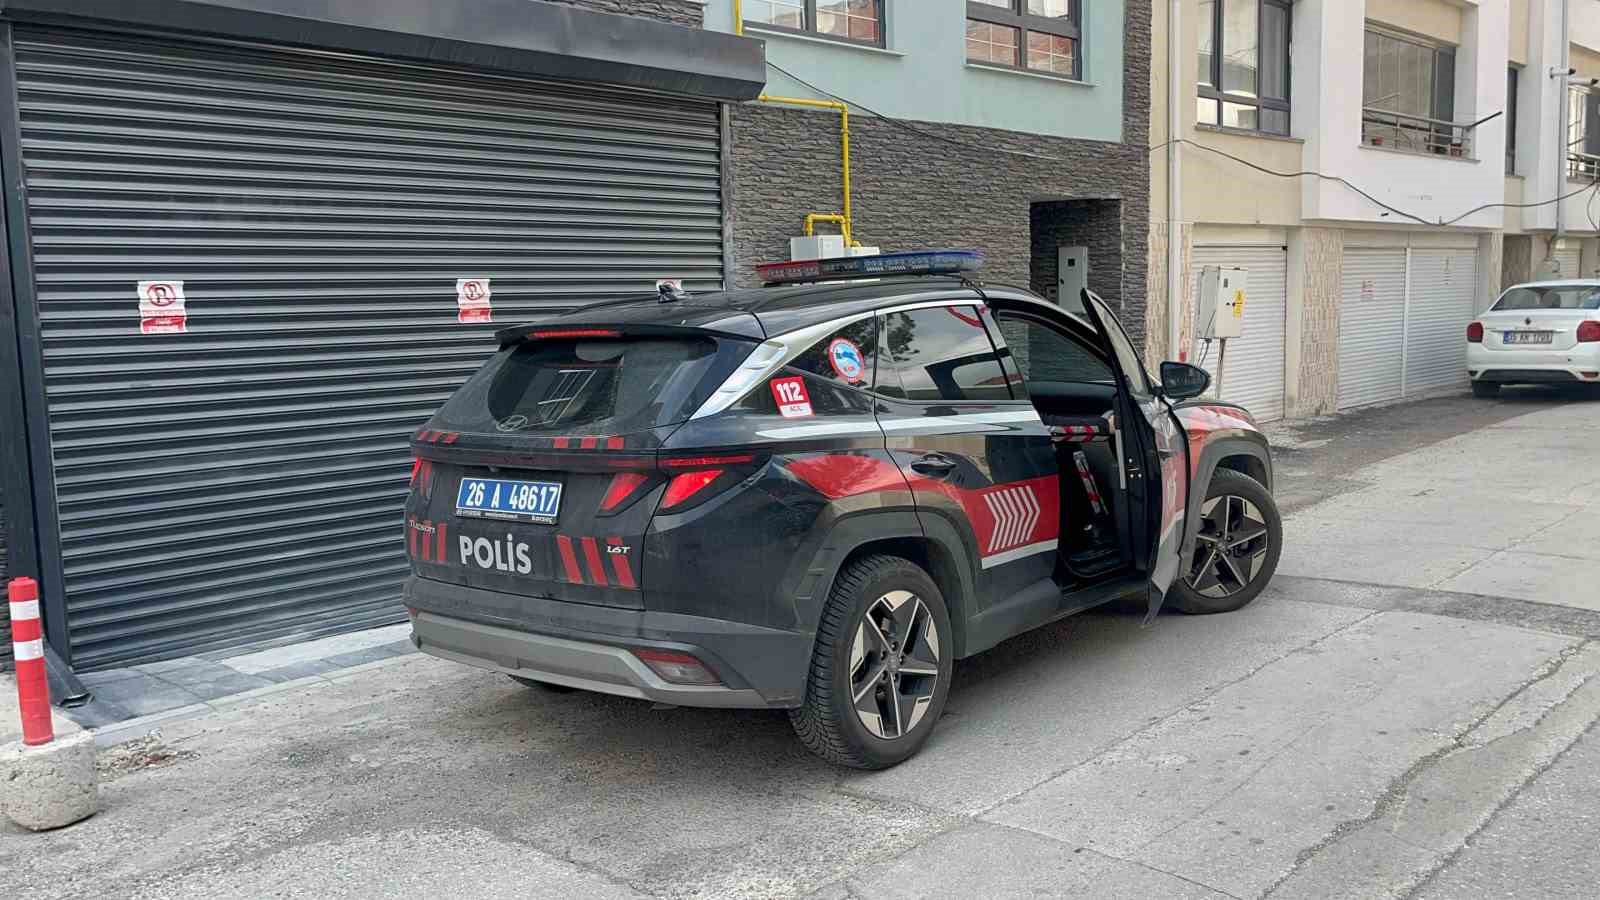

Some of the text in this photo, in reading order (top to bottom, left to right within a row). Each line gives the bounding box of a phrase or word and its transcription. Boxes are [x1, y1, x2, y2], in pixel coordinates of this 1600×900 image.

[776, 382, 804, 402] 112
[466, 482, 558, 512] 26 A 48617
[459, 533, 532, 575] POLİS
